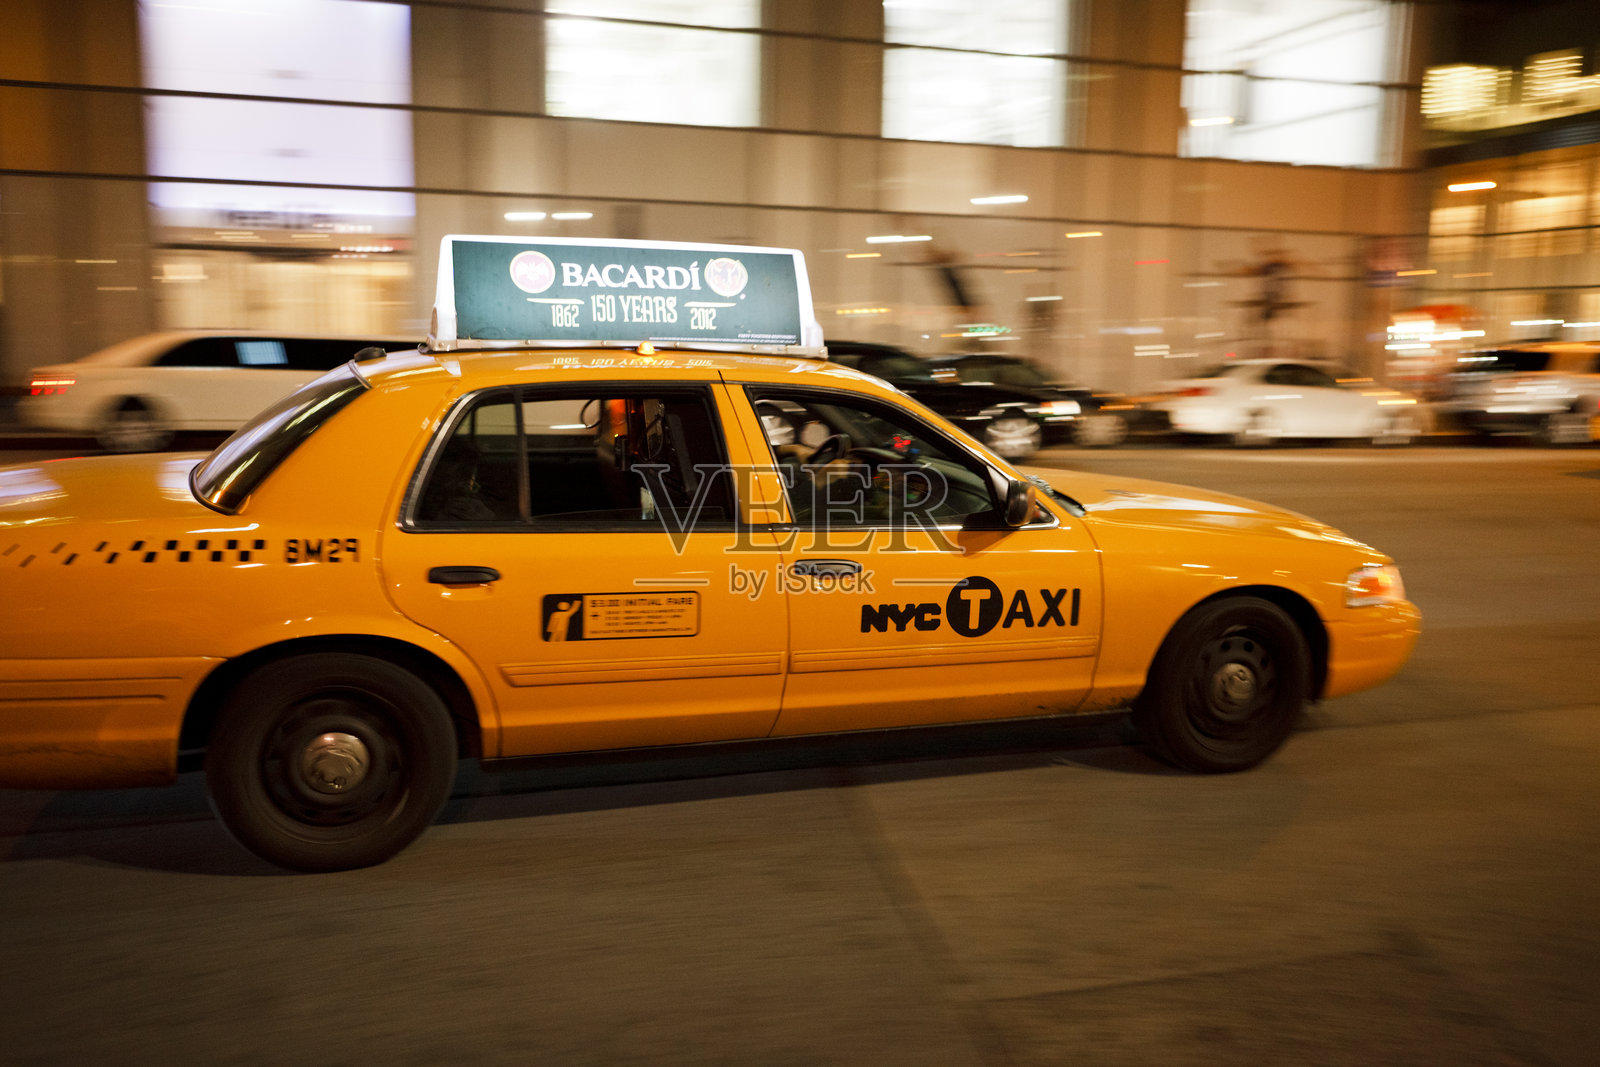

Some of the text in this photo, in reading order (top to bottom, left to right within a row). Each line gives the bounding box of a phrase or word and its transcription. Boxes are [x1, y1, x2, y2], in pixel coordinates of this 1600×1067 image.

[561, 261, 701, 290] BACARDÍ
[551, 294, 717, 330] 1862 150 YEARS 2012
[861, 583, 1081, 633] NYC TAXI
